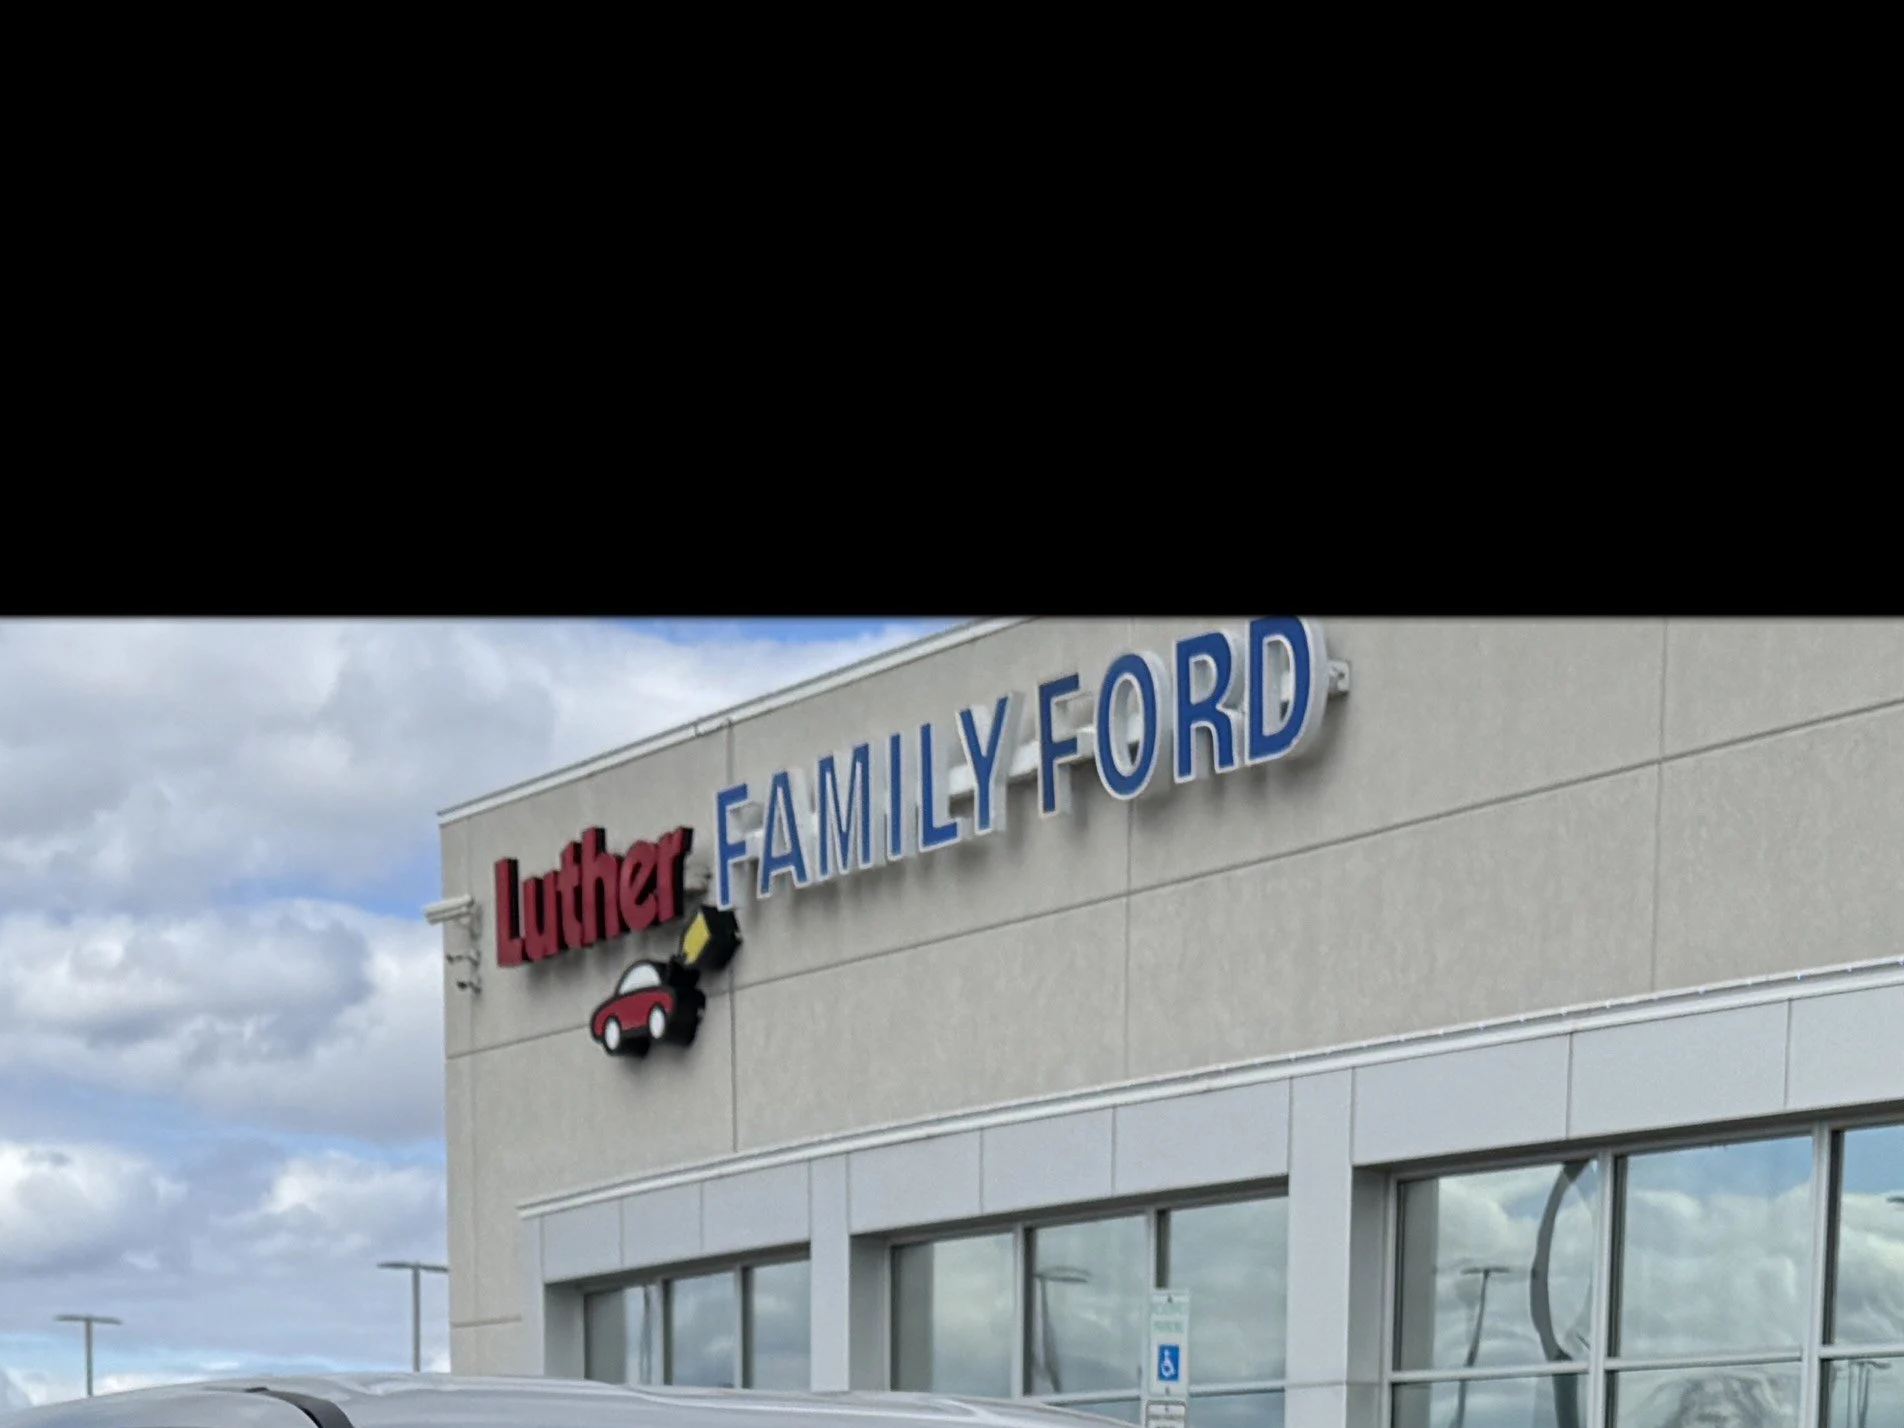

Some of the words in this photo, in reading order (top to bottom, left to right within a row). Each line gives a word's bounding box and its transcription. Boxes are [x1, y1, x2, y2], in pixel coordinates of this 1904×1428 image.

[714, 691, 1012, 911] FAMILY
[1037, 615, 1313, 819] FORD
[494, 824, 694, 967] Luther
